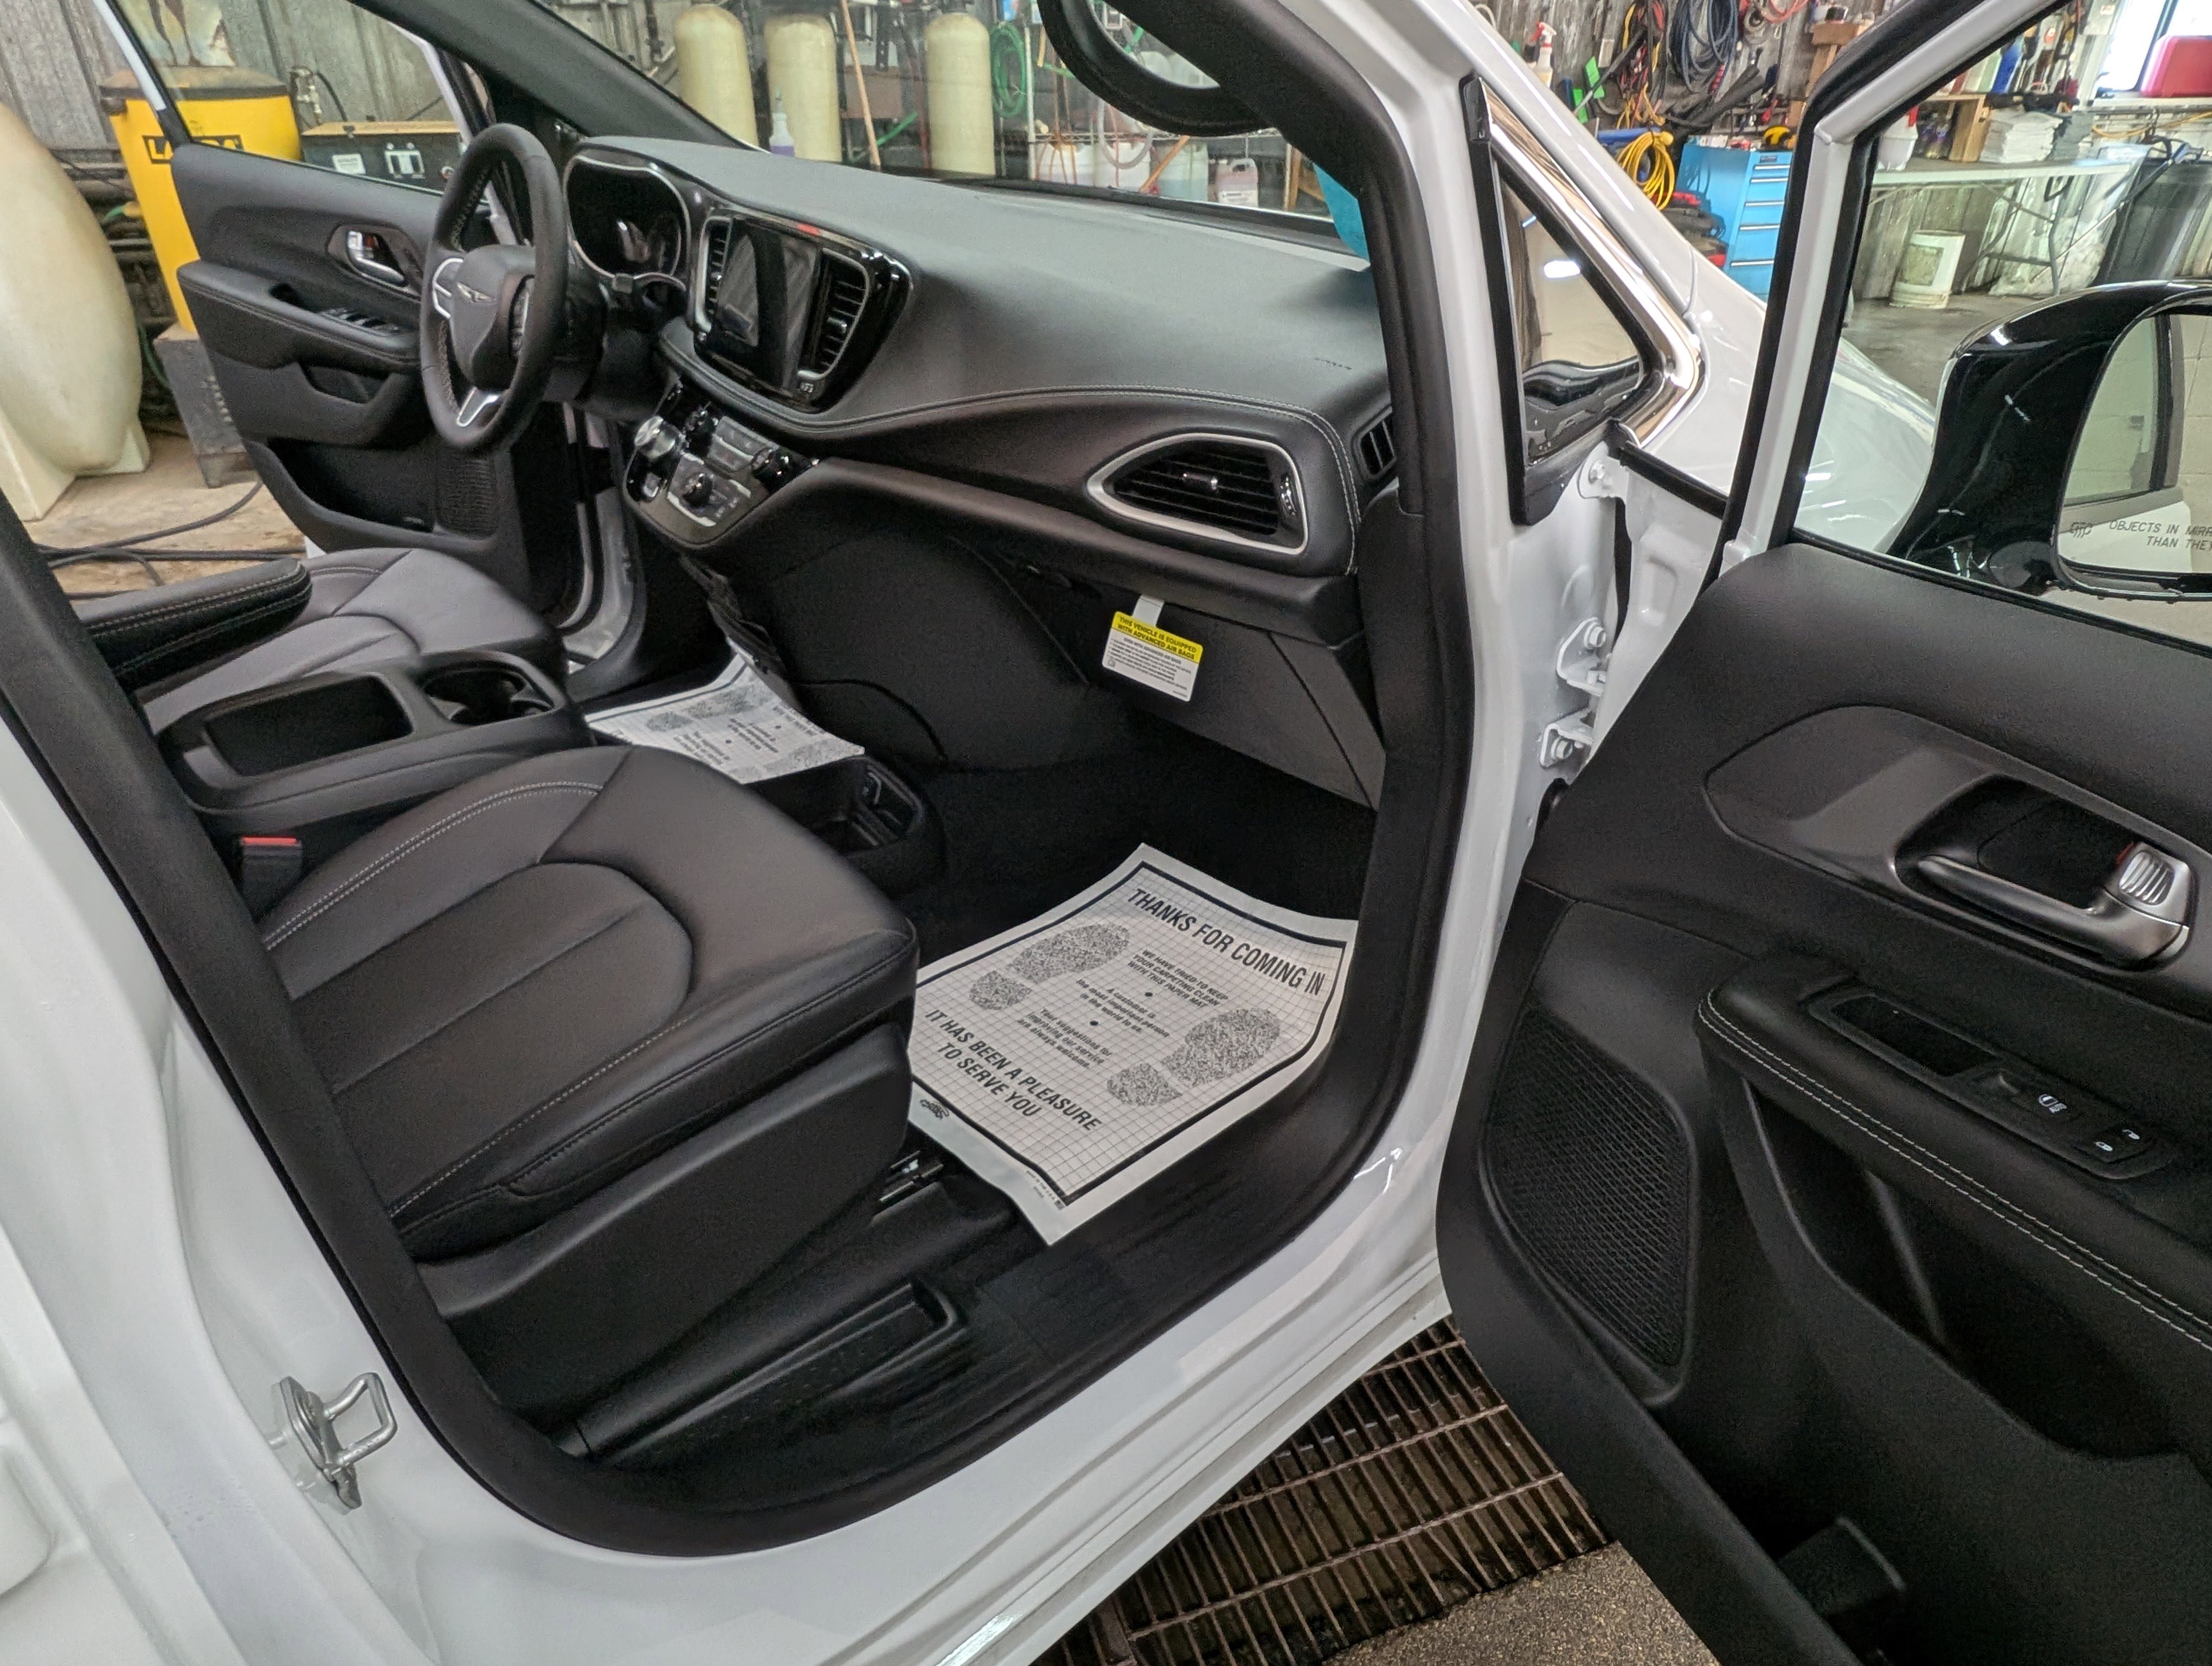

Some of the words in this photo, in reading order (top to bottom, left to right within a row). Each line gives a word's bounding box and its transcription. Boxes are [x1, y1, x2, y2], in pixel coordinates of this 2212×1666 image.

[2109, 521, 2161, 533] OBJECTS
[2165, 524, 2179, 534] IN
[2146, 536, 2179, 548] THAN
[1117, 624, 1133, 634] WITH
[1133, 631, 1166, 648] ADVANCED
[1167, 644, 1178, 652] AIR
[1178, 649, 1195, 659] BAGS
[1119, 617, 1133, 626] THIS
[1134, 623, 1158, 637] VEHICLE
[1166, 636, 1197, 653] EQUIPPED
[1128, 888, 1196, 932] THANKS
[1192, 923, 1234, 953] FOR
[1231, 943, 1307, 988] COMING
[1304, 970, 1326, 996] IN
[1127, 960, 1149, 975] WITH
[1147, 972, 1166, 985] THIS
[1164, 982, 1190, 999] PAPER
[1188, 997, 1208, 1008] MAT
[1133, 954, 1154, 968] YOUR
[1153, 966, 1195, 992] CARPETING
[1193, 990, 1220, 1006] CLEAN
[1142, 950, 1156, 959] WE
[1154, 957, 1175, 970] HAVE
[1174, 968, 1197, 983] TRIED
[1196, 981, 1208, 990] TO
[1207, 988, 1229, 1000] KEEP
[1076, 978, 1089, 989] the
[1089, 988, 1109, 1000] most
[1107, 998, 1144, 1023] important
[1141, 1020, 1170, 1037] person
[1088, 998, 1102, 1008] the
[1101, 1007, 1125, 1021] world
[1113, 992, 1148, 1014] customer
[1017, 1019, 1032, 1028] are
[1030, 1027, 1057, 1046] always
[1040, 1008, 1058, 1021] Your
[1056, 1020, 1101, 1050] suggestions
[1099, 1047, 1113, 1056] for
[1062, 1036, 1077, 1047] our
[1076, 1045, 1105, 1064] service
[925, 1010, 948, 1022] IT
[940, 1019, 975, 1043] HAS
[968, 1040, 1012, 1070] BEEN
[1005, 1067, 1023, 1080] A
[1018, 1076, 1102, 1131] PLEASURE
[937, 1042, 963, 1060] TO
[957, 1058, 1009, 1095] SERVE
[1005, 1091, 1043, 1117] YOU
